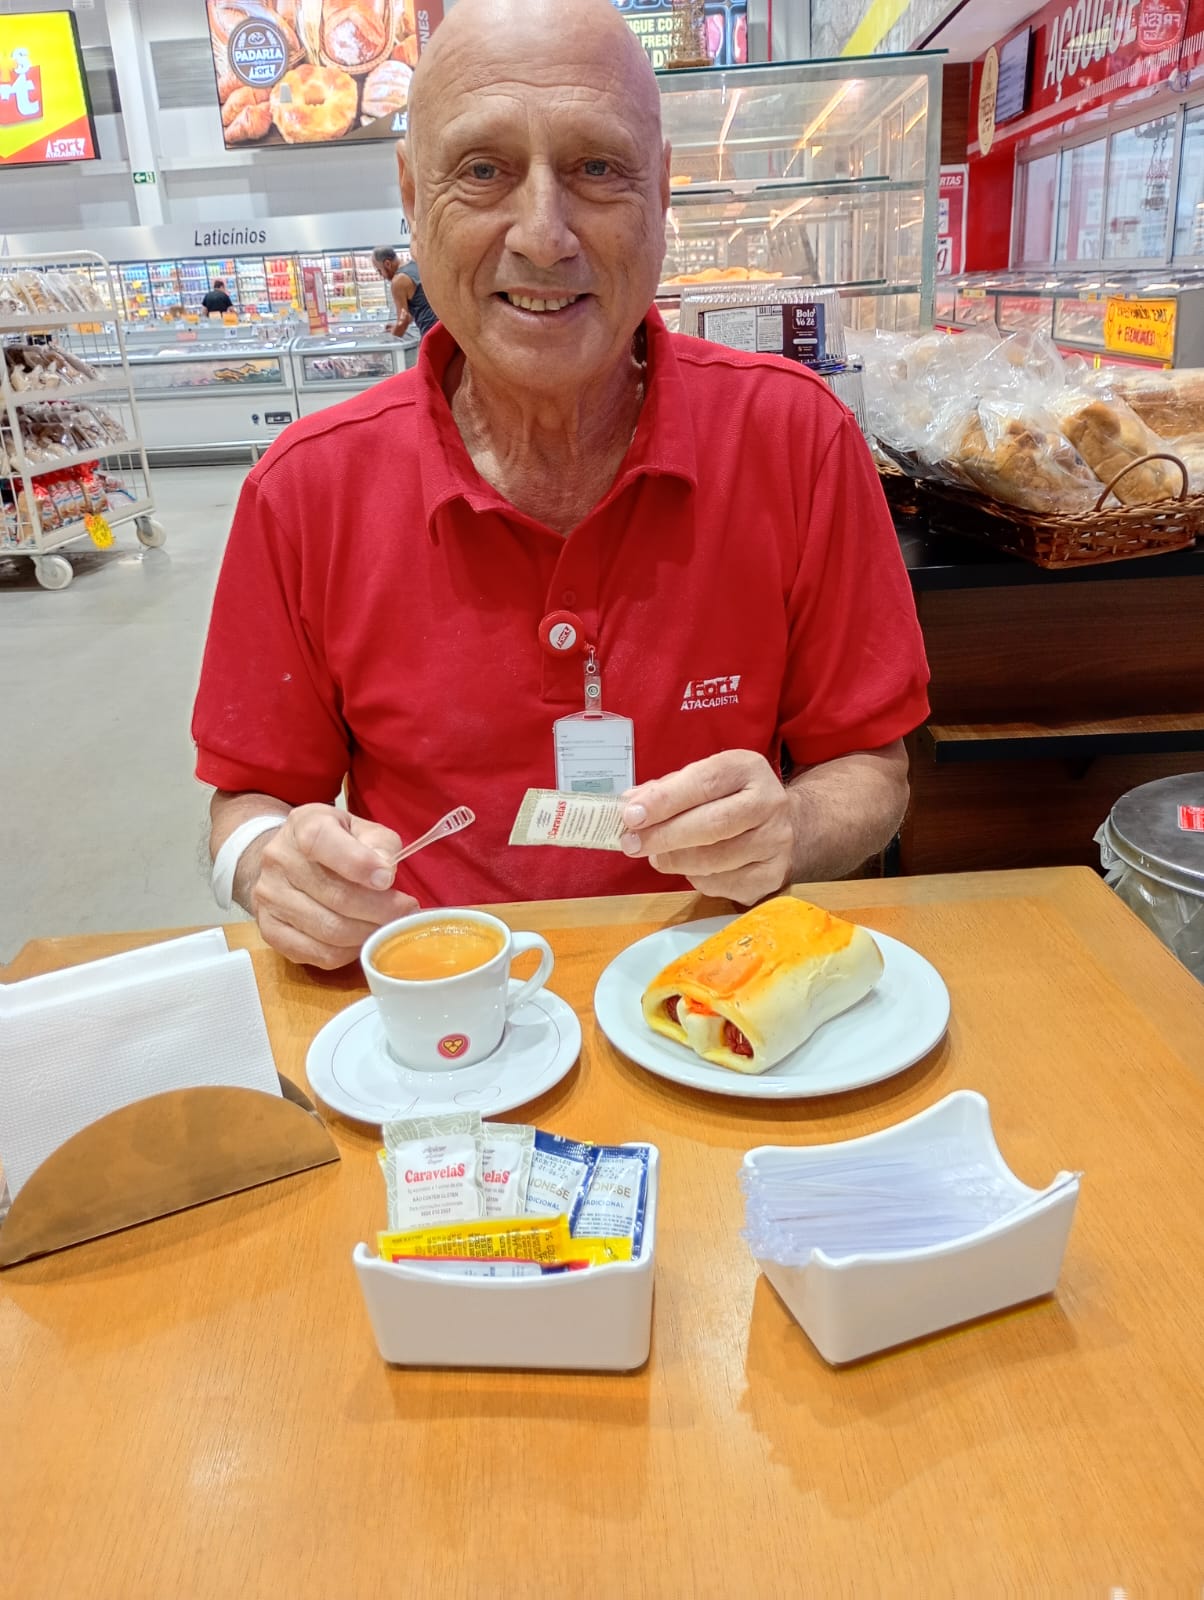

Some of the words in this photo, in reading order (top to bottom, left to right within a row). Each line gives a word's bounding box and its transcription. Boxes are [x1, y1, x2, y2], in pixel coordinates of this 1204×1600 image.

[235, 48, 283, 62] PADARIA
[194, 227, 267, 247] Laticínios
[683, 675, 741, 699] Fort
[680, 694, 739, 711] ATACADISTA
